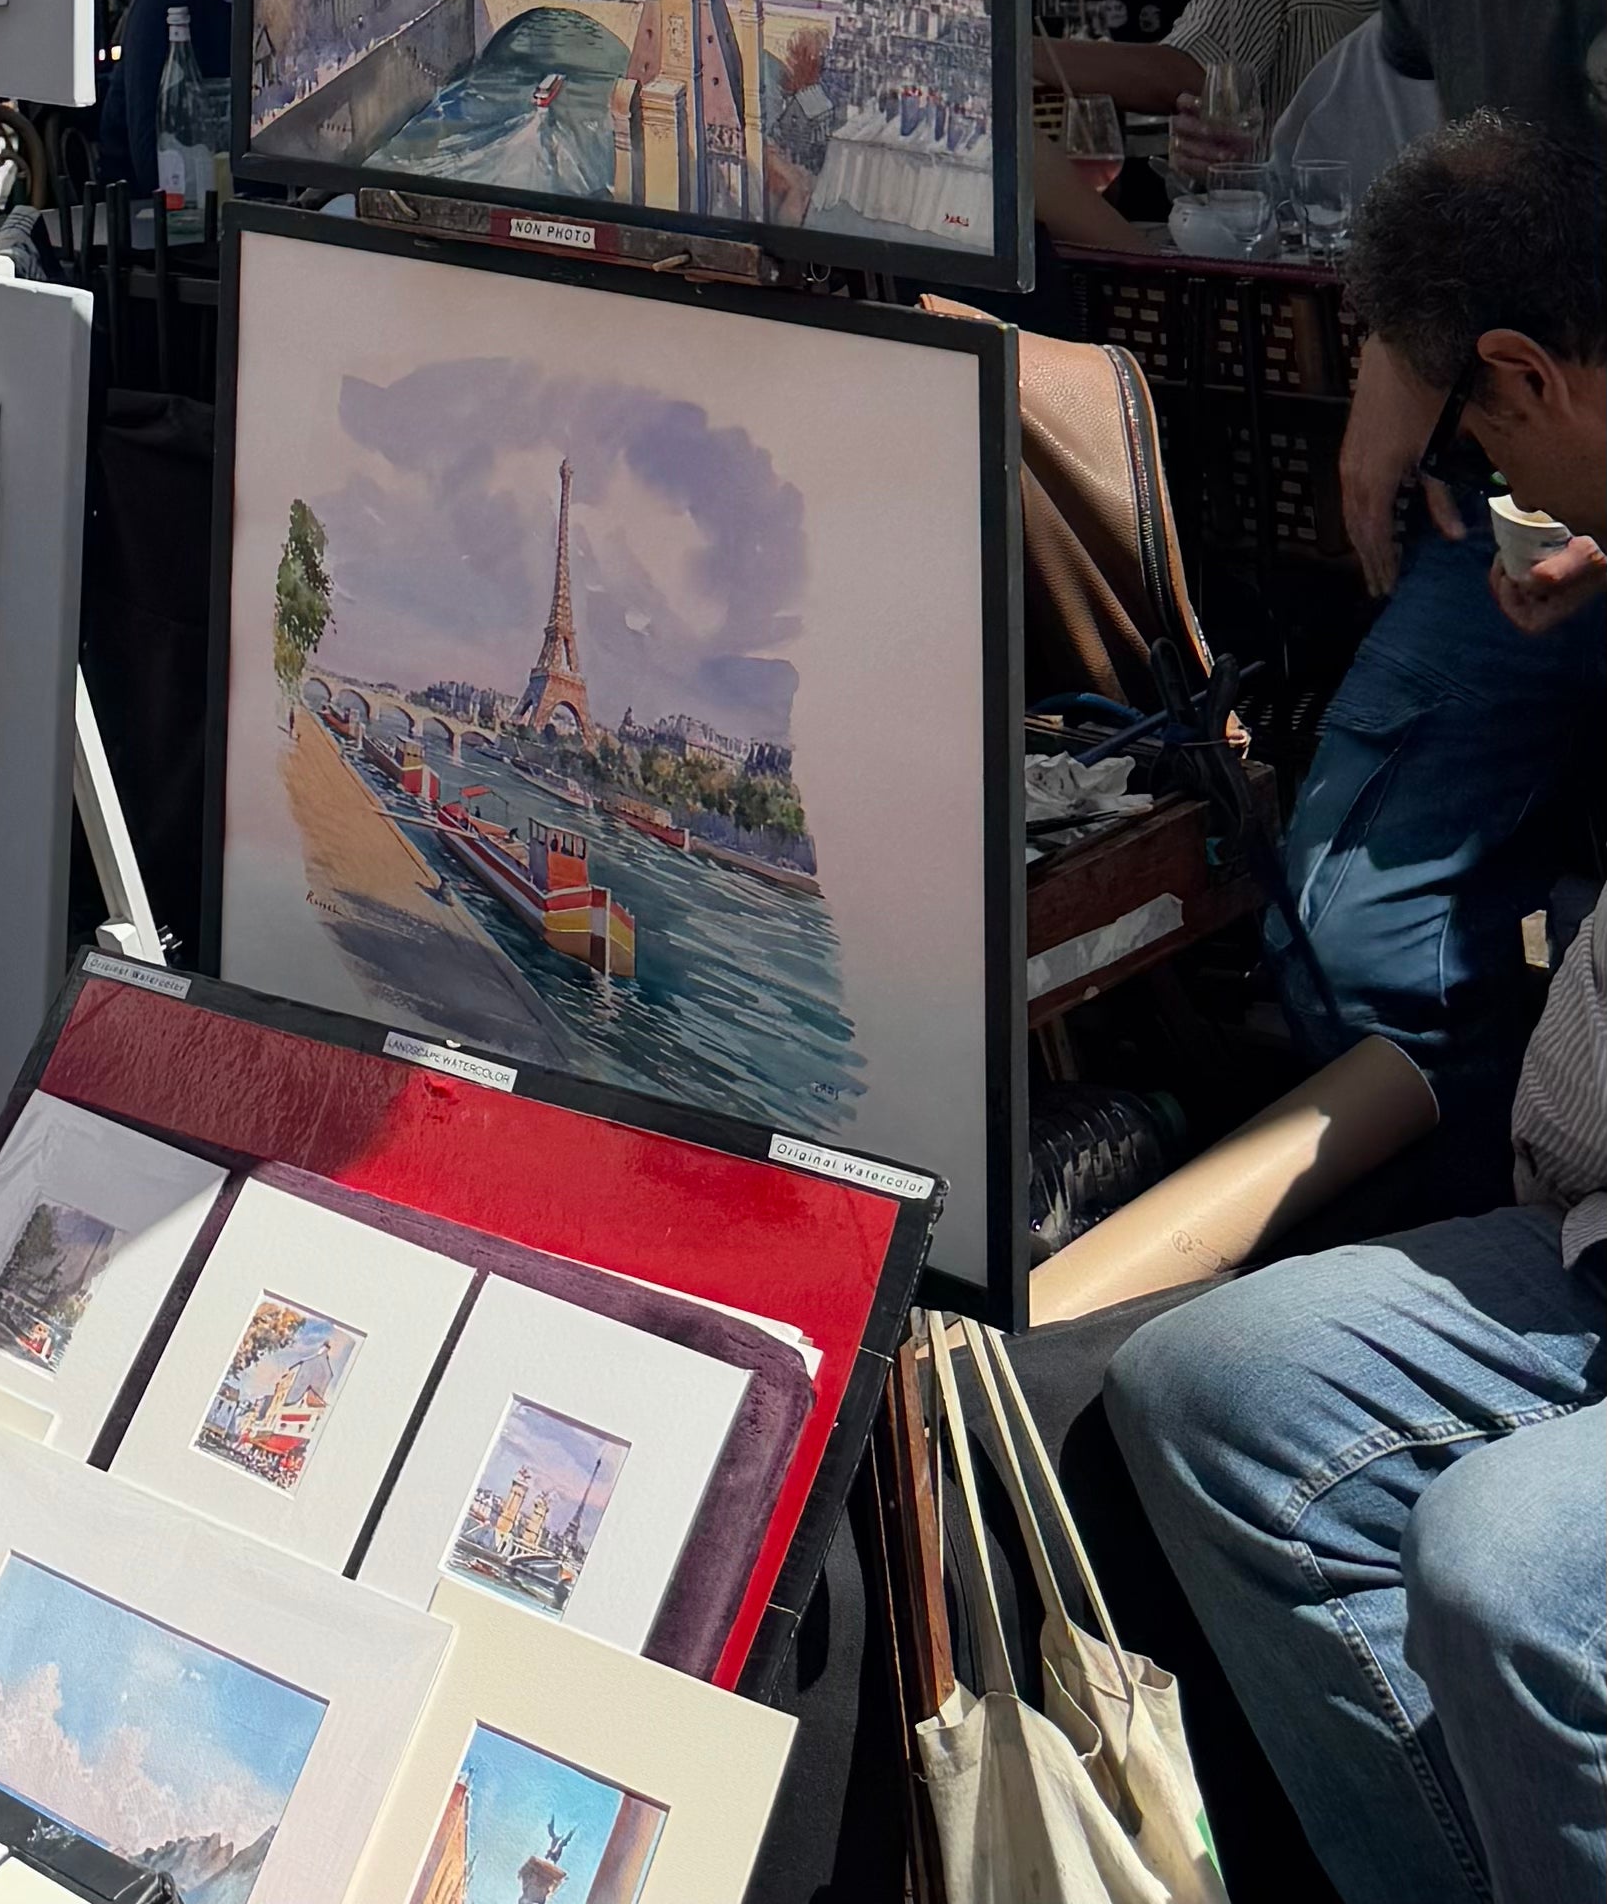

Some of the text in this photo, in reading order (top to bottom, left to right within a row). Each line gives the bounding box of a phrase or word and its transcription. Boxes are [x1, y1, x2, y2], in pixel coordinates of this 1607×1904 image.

[515, 221, 591, 244] NON PHOTO
[388, 1038, 511, 1084] LANDSCAPE WATERCOLOR
[776, 1143, 924, 1194] Original Watercolor
